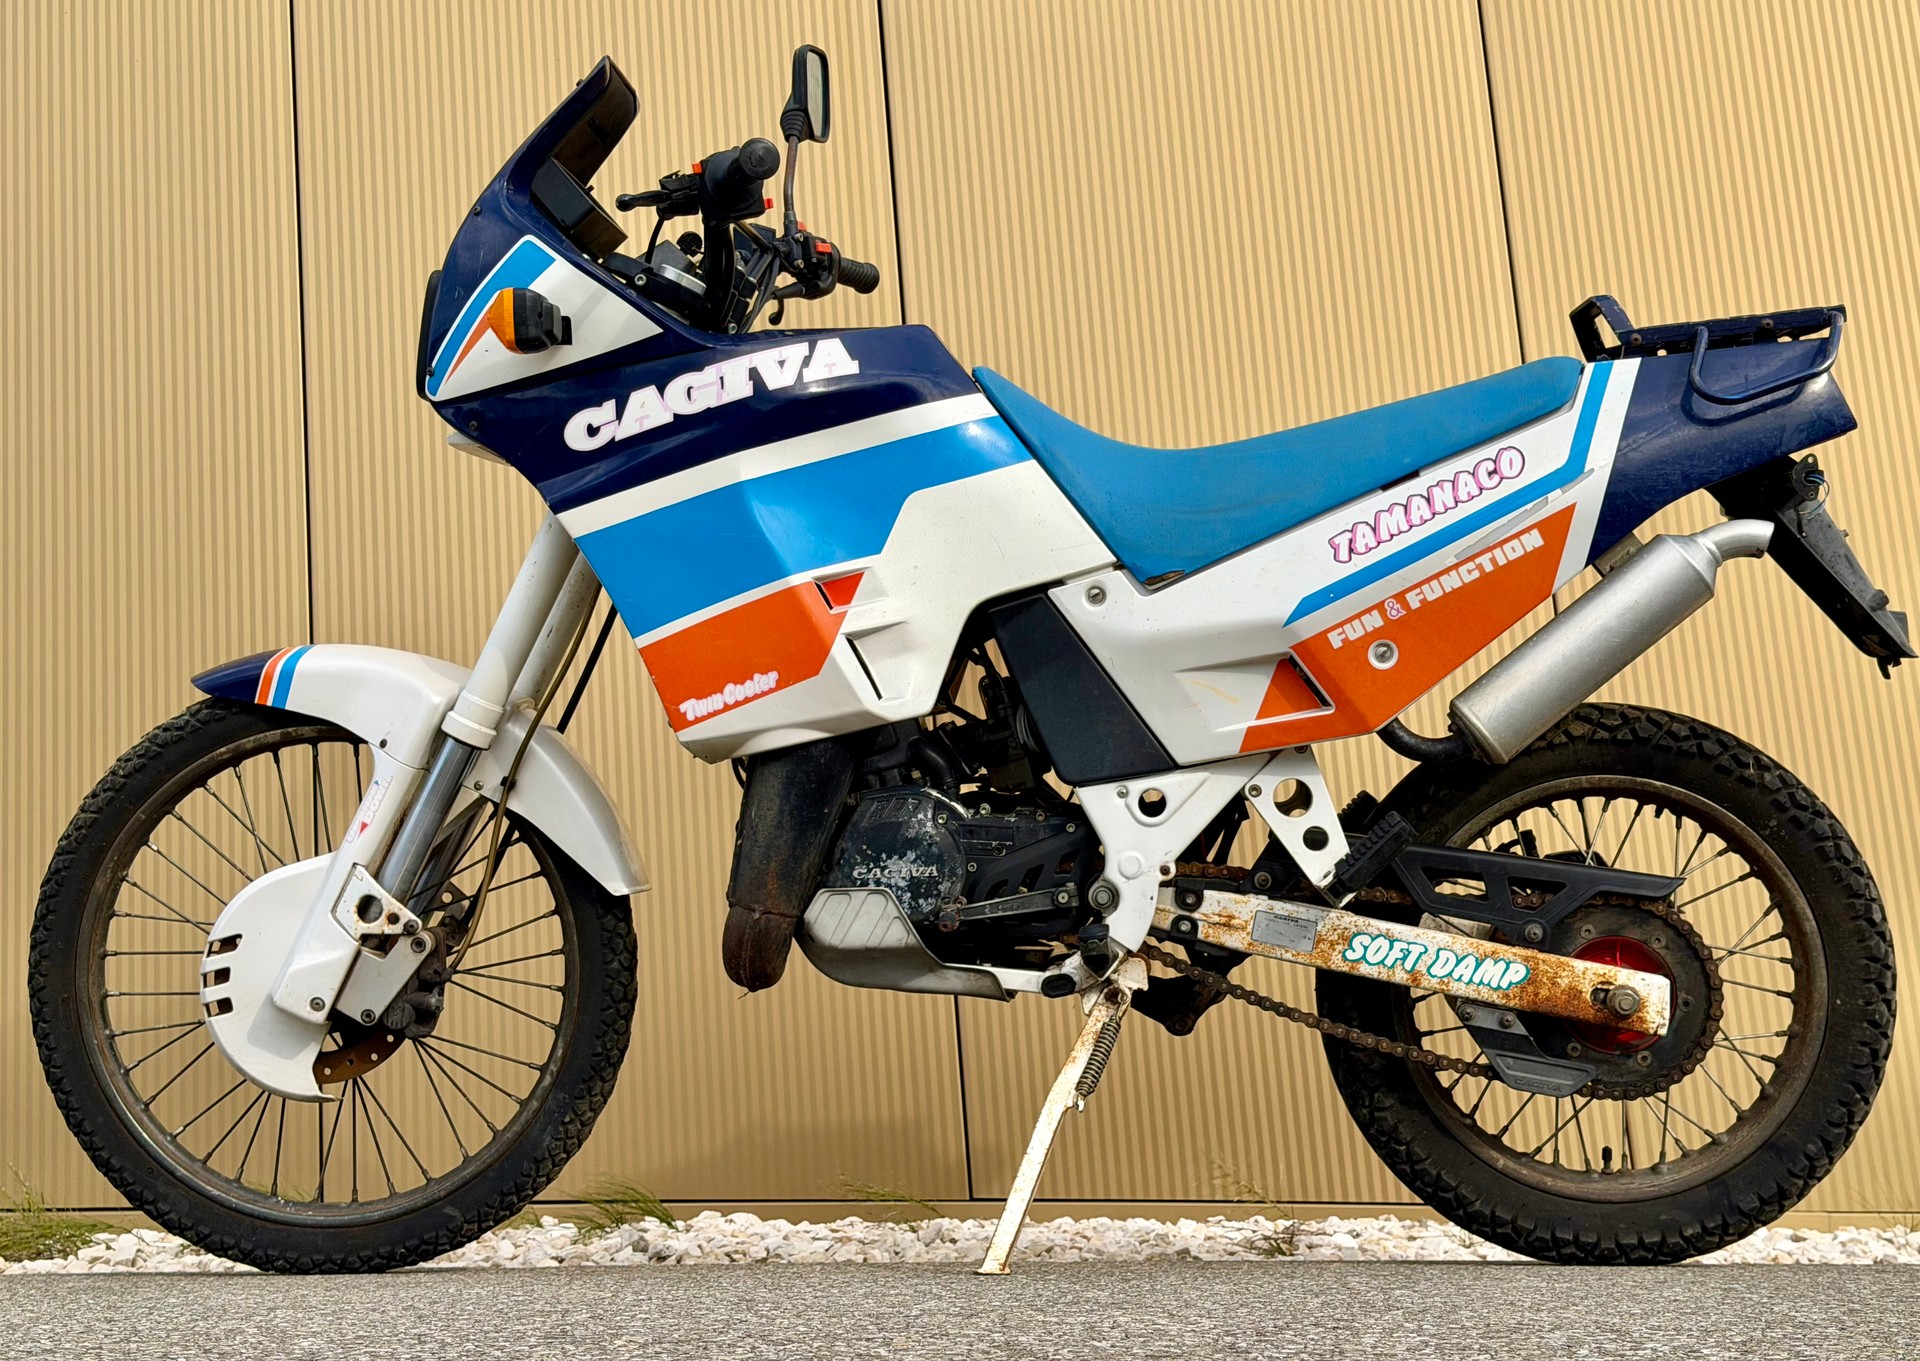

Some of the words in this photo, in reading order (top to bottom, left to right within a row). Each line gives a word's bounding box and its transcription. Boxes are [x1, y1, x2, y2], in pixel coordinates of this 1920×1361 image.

[564, 338, 860, 451] CAGIVA
[1328, 446, 1525, 564] TAMANACO
[1327, 609, 1384, 650] FUN
[1384, 598, 1406, 620] &
[1405, 528, 1545, 610] FUNCTION
[853, 865, 939, 879] CAGIVA
[1341, 931, 1428, 973] SOFT
[1427, 947, 1530, 990] DAMP
